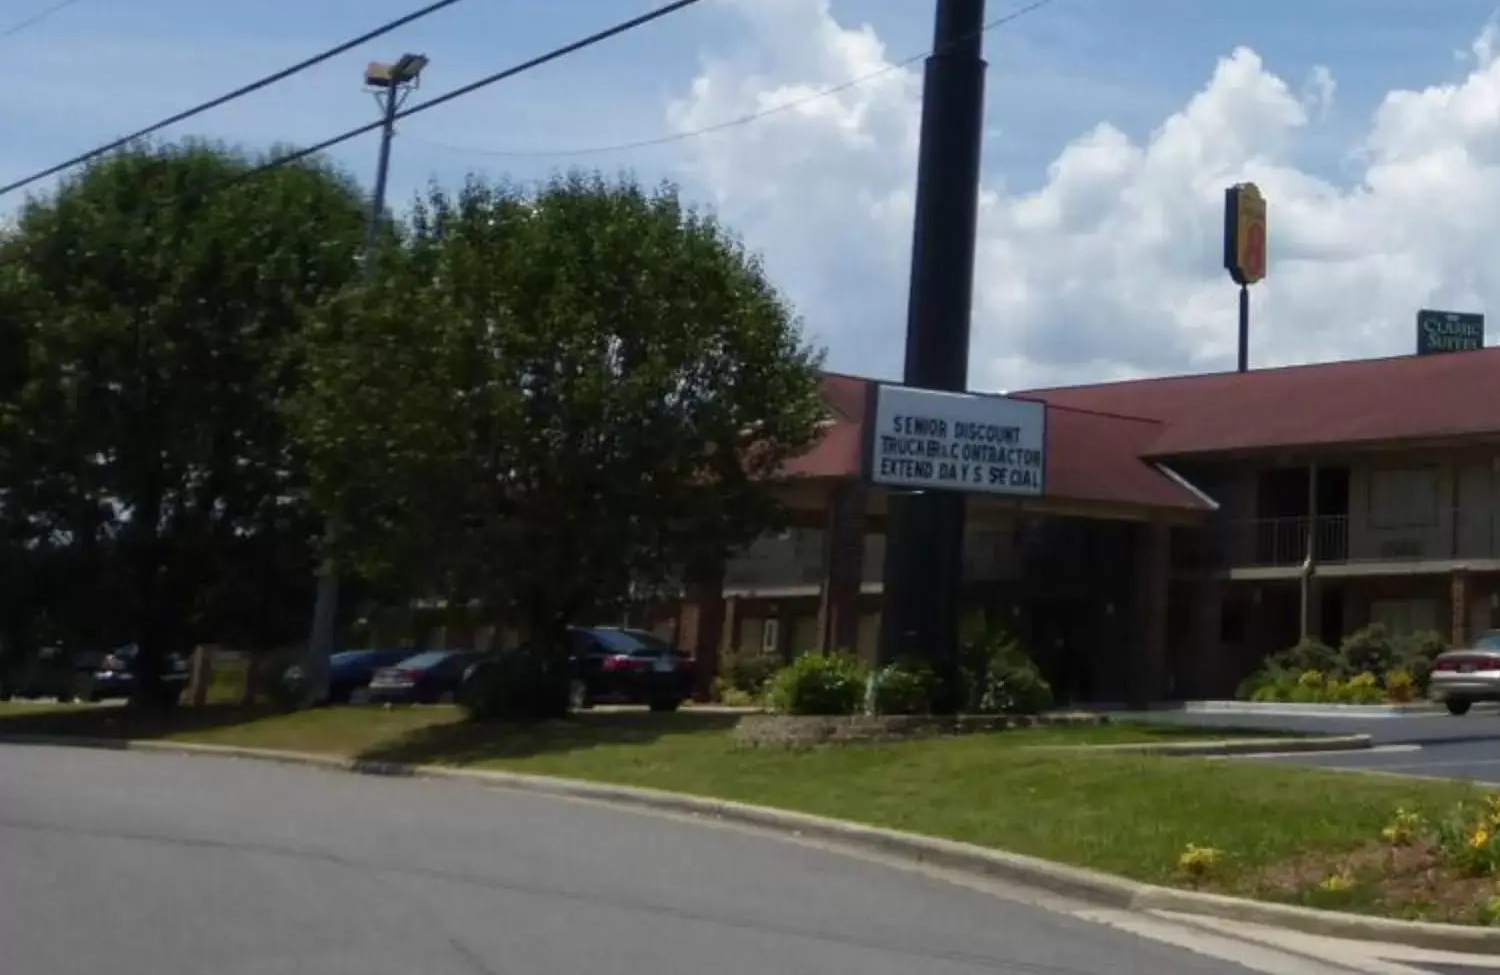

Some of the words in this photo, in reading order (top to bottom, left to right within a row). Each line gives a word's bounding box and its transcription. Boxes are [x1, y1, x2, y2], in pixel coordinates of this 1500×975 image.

[893, 416, 947, 439] SENIOR
[954, 421, 1021, 443] DISCOUNT
[881, 457, 933, 479] EXTEND
